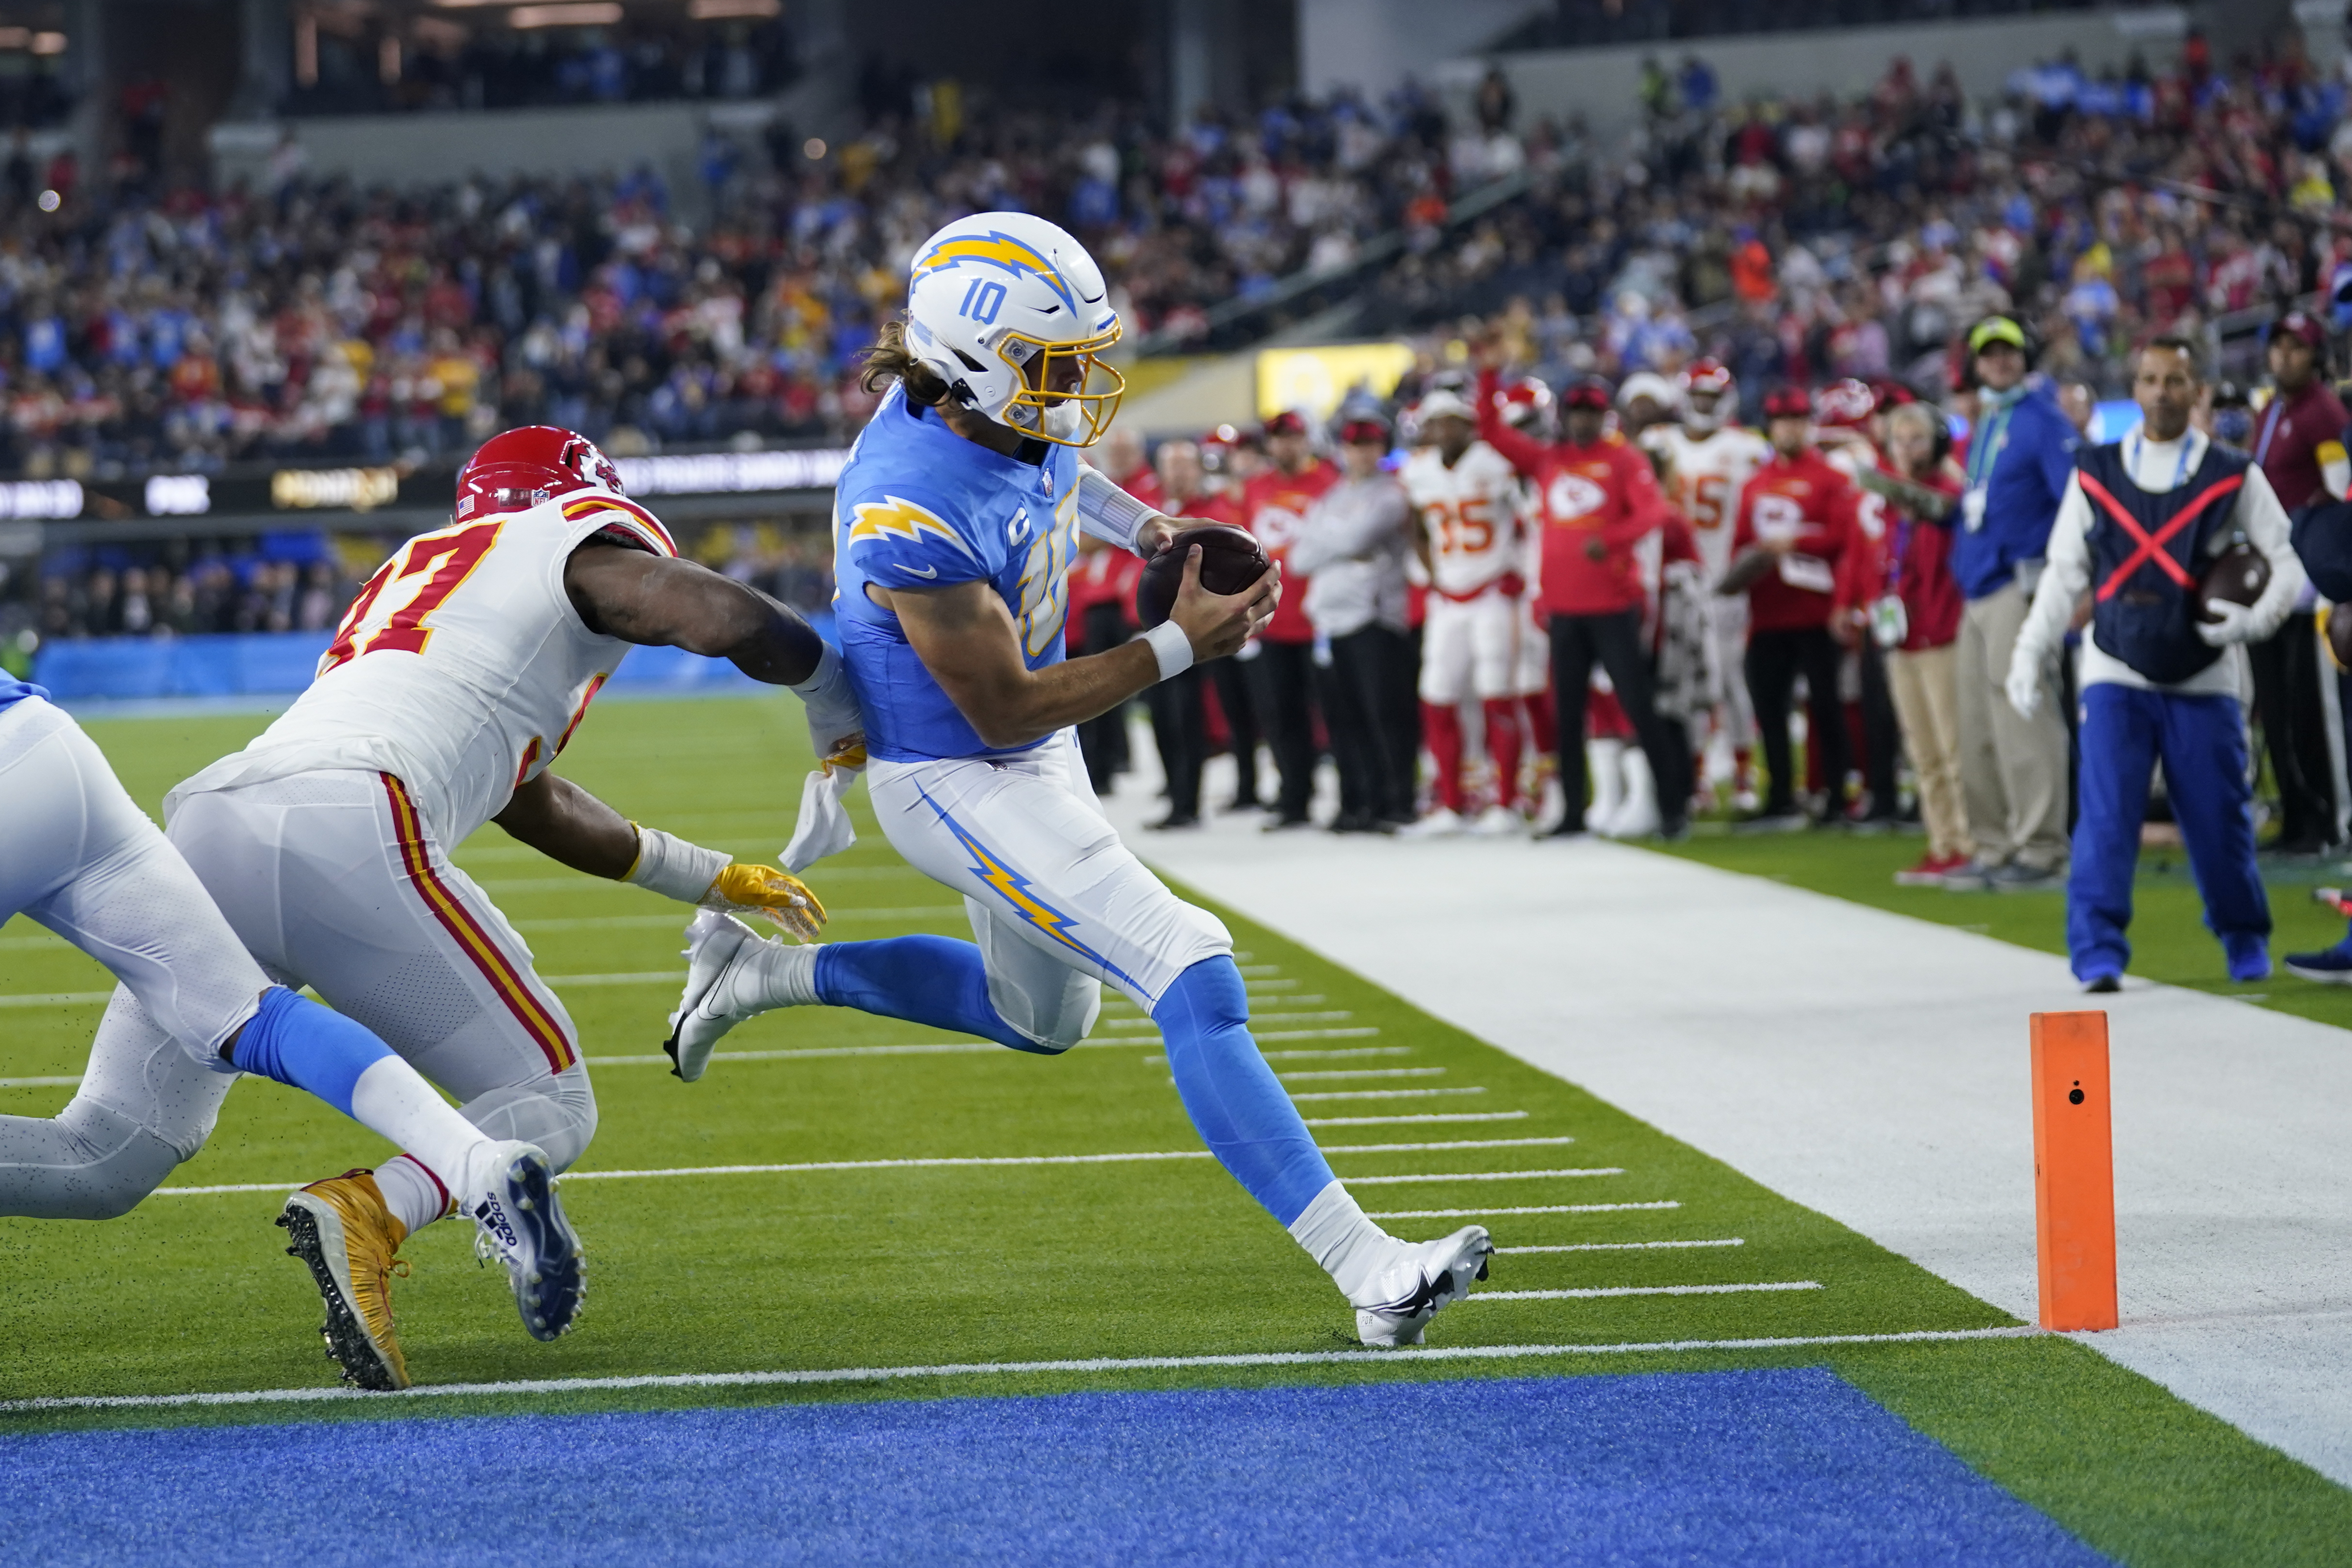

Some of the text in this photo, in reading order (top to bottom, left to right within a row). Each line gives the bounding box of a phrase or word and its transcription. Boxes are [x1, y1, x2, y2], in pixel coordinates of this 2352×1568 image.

[959, 278, 1007, 325] 10
[1008, 507, 1030, 546] C
[318, 519, 508, 677] 97
[487, 1191, 517, 1246] adidas
[1359, 1315, 1373, 1325] POR
